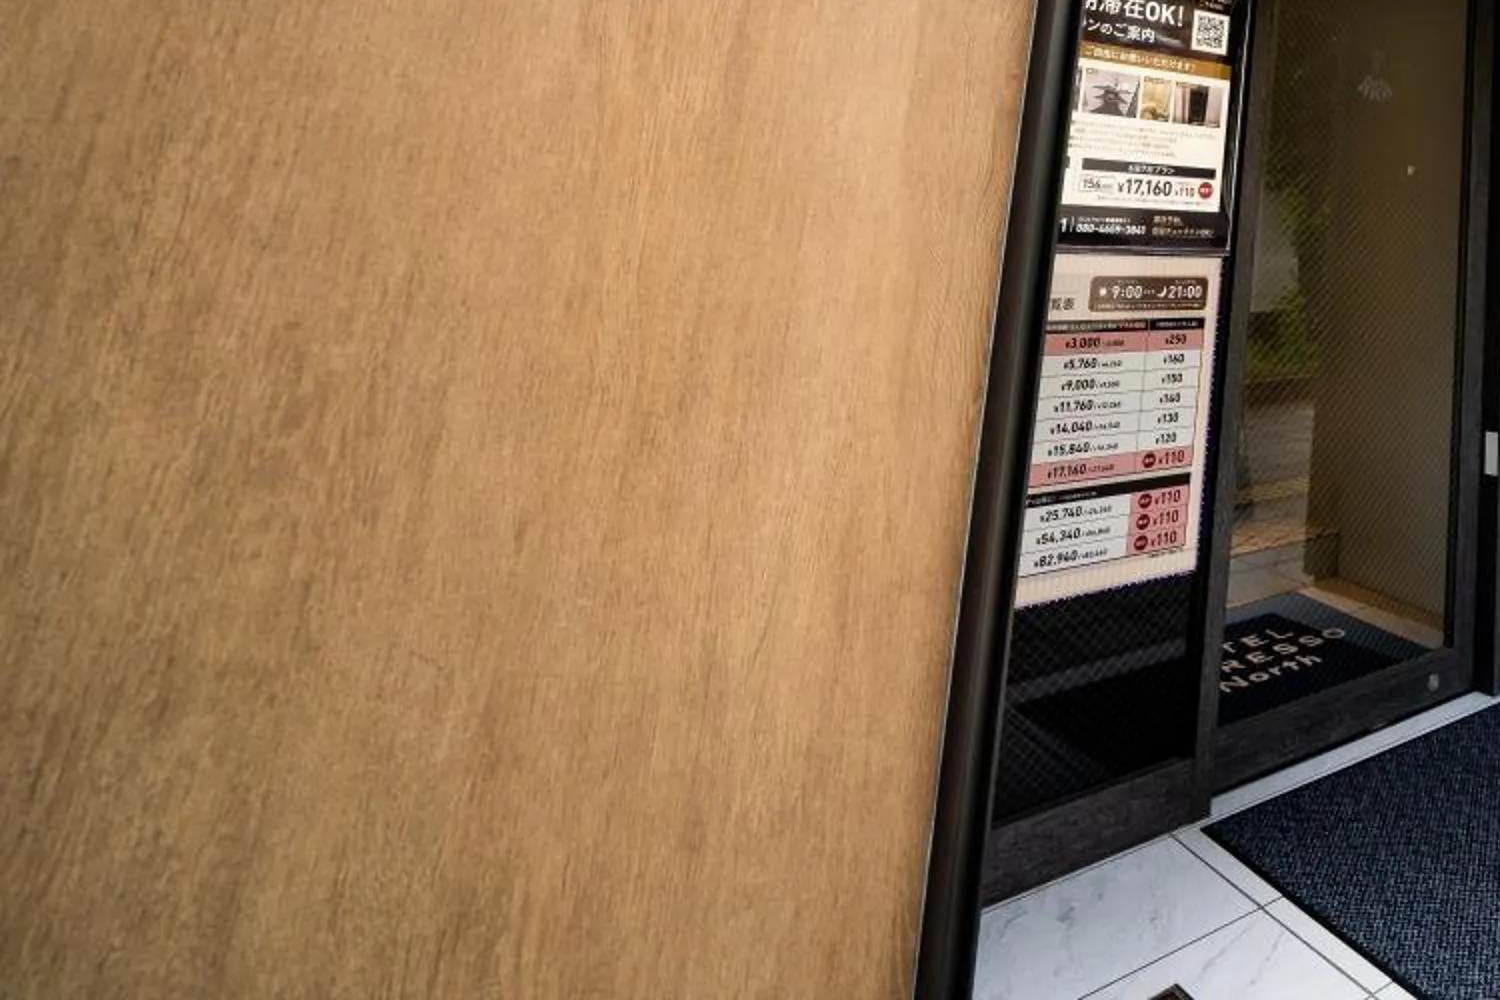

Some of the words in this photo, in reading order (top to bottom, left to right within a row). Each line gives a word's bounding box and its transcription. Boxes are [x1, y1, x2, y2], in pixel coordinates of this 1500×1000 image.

[1083, 17, 1156, 44] ンのご案内
[1117, 177, 1173, 197] ¥17,160
[1111, 284, 1143, 300] 9:00
[1167, 285, 1203, 299] 21:00
[1219, 655, 1323, 693] North
